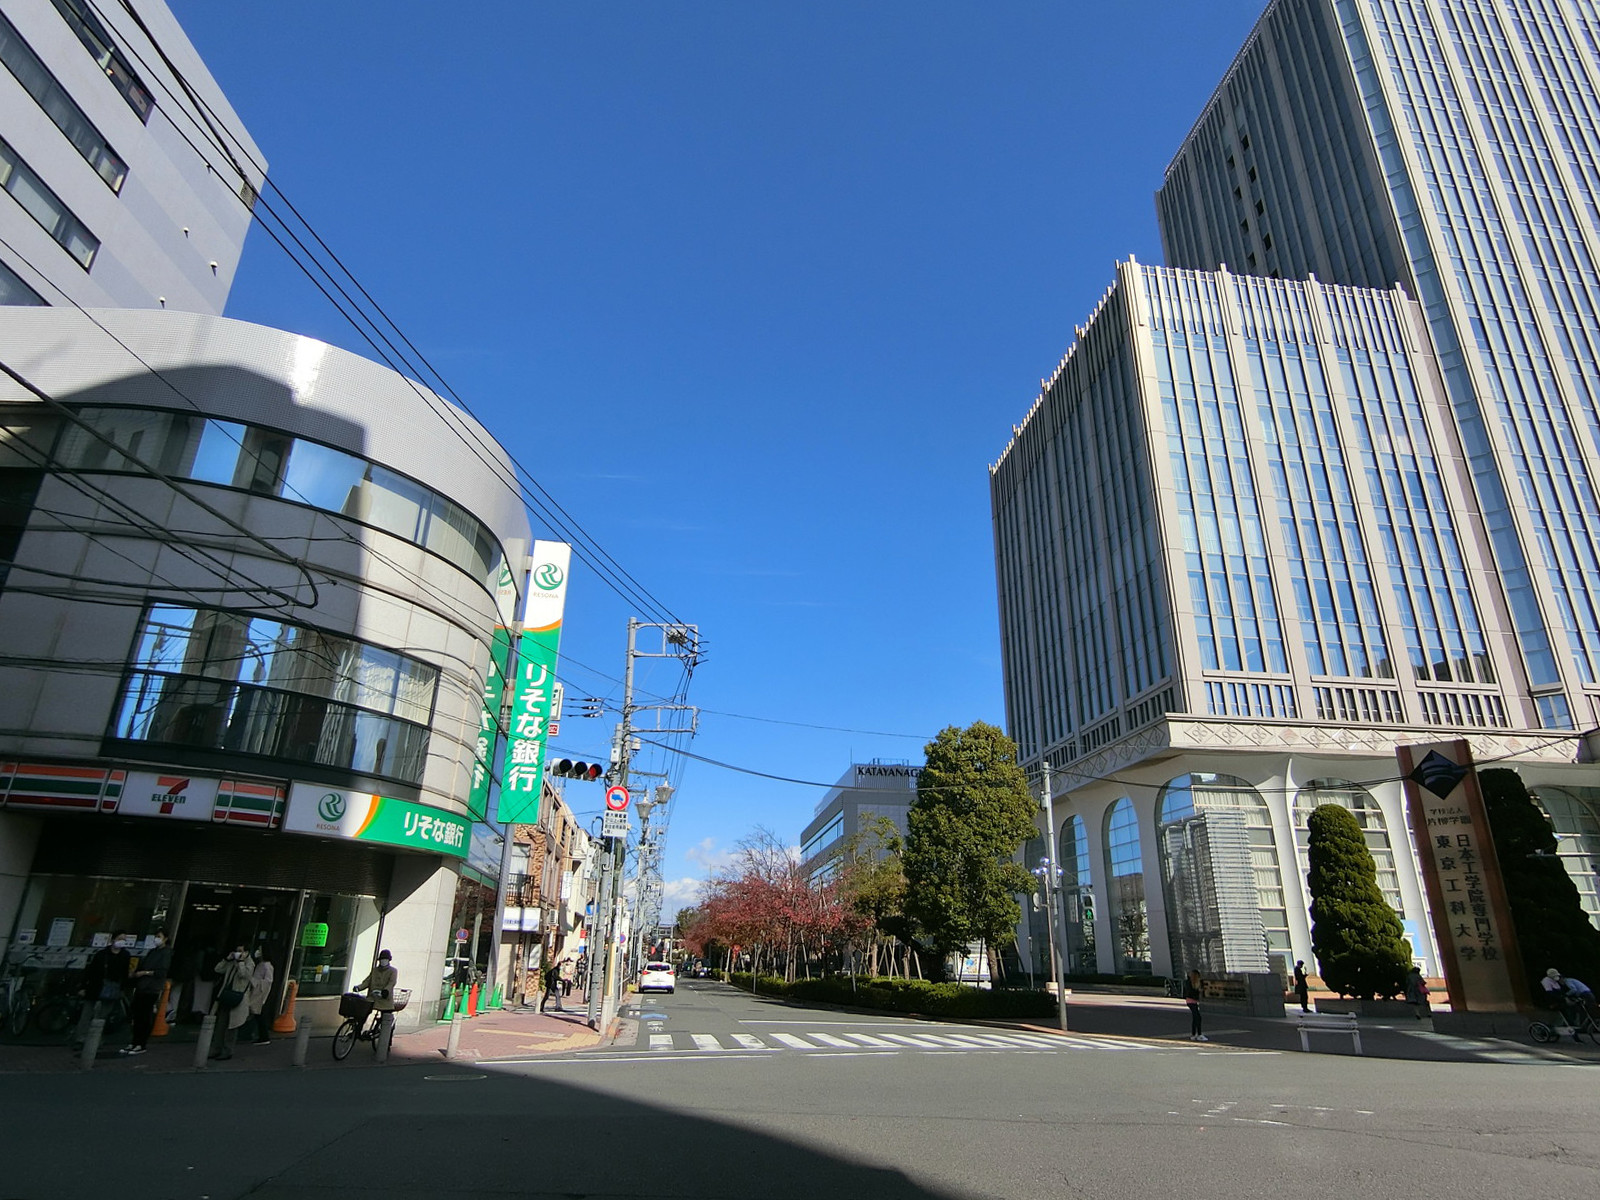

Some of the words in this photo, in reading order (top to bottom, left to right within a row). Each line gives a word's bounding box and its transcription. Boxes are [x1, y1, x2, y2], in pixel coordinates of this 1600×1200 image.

[533, 591, 559, 599] RESONA
[509, 663, 548, 792] りそな銀行
[857, 766, 922, 778] KATAYANAG
[157, 776, 190, 814] 7
[316, 823, 341, 832] RESONA
[404, 811, 465, 848] りそな銀行
[1434, 835, 1477, 960] 東京工科大学
[1456, 834, 1498, 960] 日本工学院専門学校
